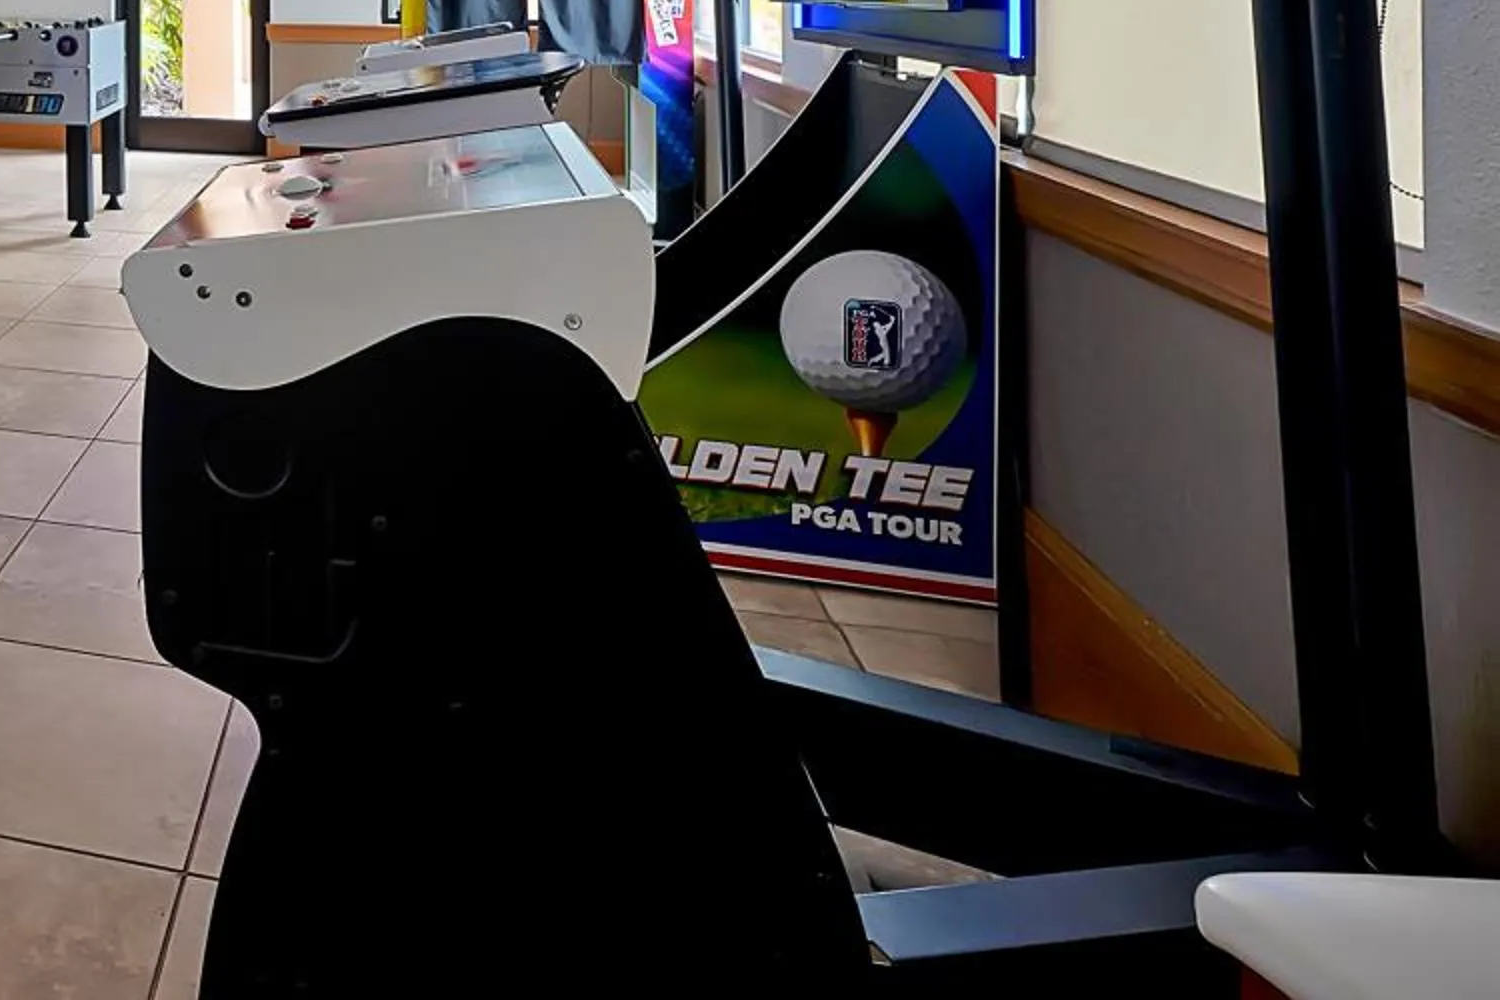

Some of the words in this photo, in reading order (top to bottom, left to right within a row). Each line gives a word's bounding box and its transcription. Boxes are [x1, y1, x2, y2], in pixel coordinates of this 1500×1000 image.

[654, 434, 827, 494] LDEN
[845, 455, 976, 512] TEE
[791, 503, 862, 533] PGA
[866, 511, 963, 546] TOUR
